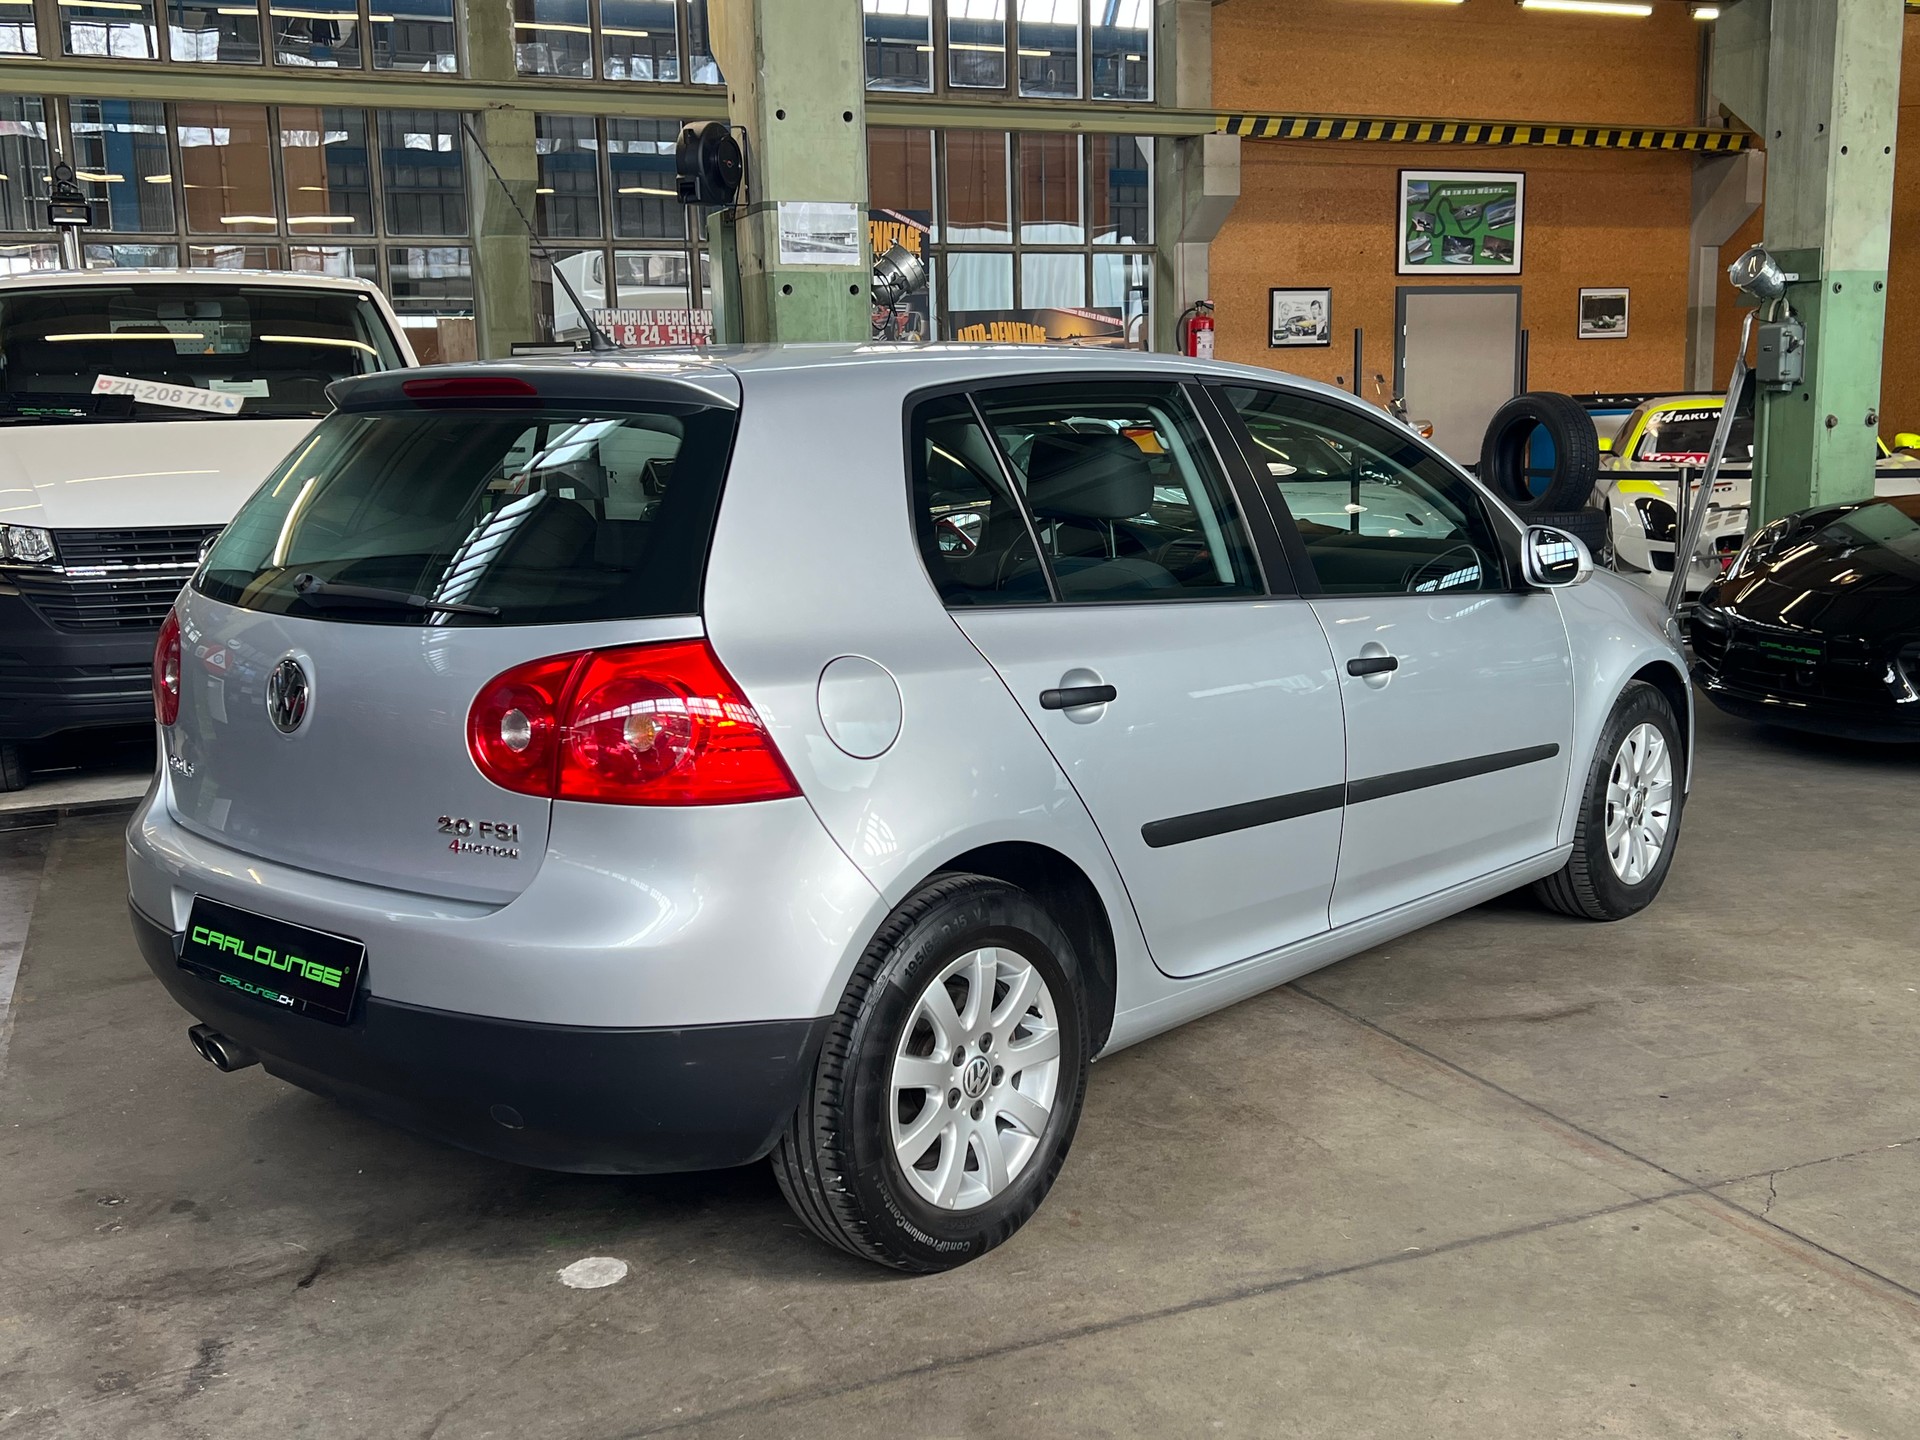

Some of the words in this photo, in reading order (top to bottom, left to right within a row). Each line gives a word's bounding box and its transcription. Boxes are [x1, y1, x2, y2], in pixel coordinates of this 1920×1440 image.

[595, 310, 655, 325] MEMORIAL
[624, 325, 637, 345] &
[640, 325, 666, 345] 24.
[1674, 412, 1708, 422] BAKU
[479, 821, 519, 843] FSI
[448, 838, 519, 860] 4MOTION
[191, 925, 343, 988] CARLOUNGE
[219, 974, 295, 1007] CARLOUNGE.CH
[875, 1179, 971, 1253] ContiPremiumContact
